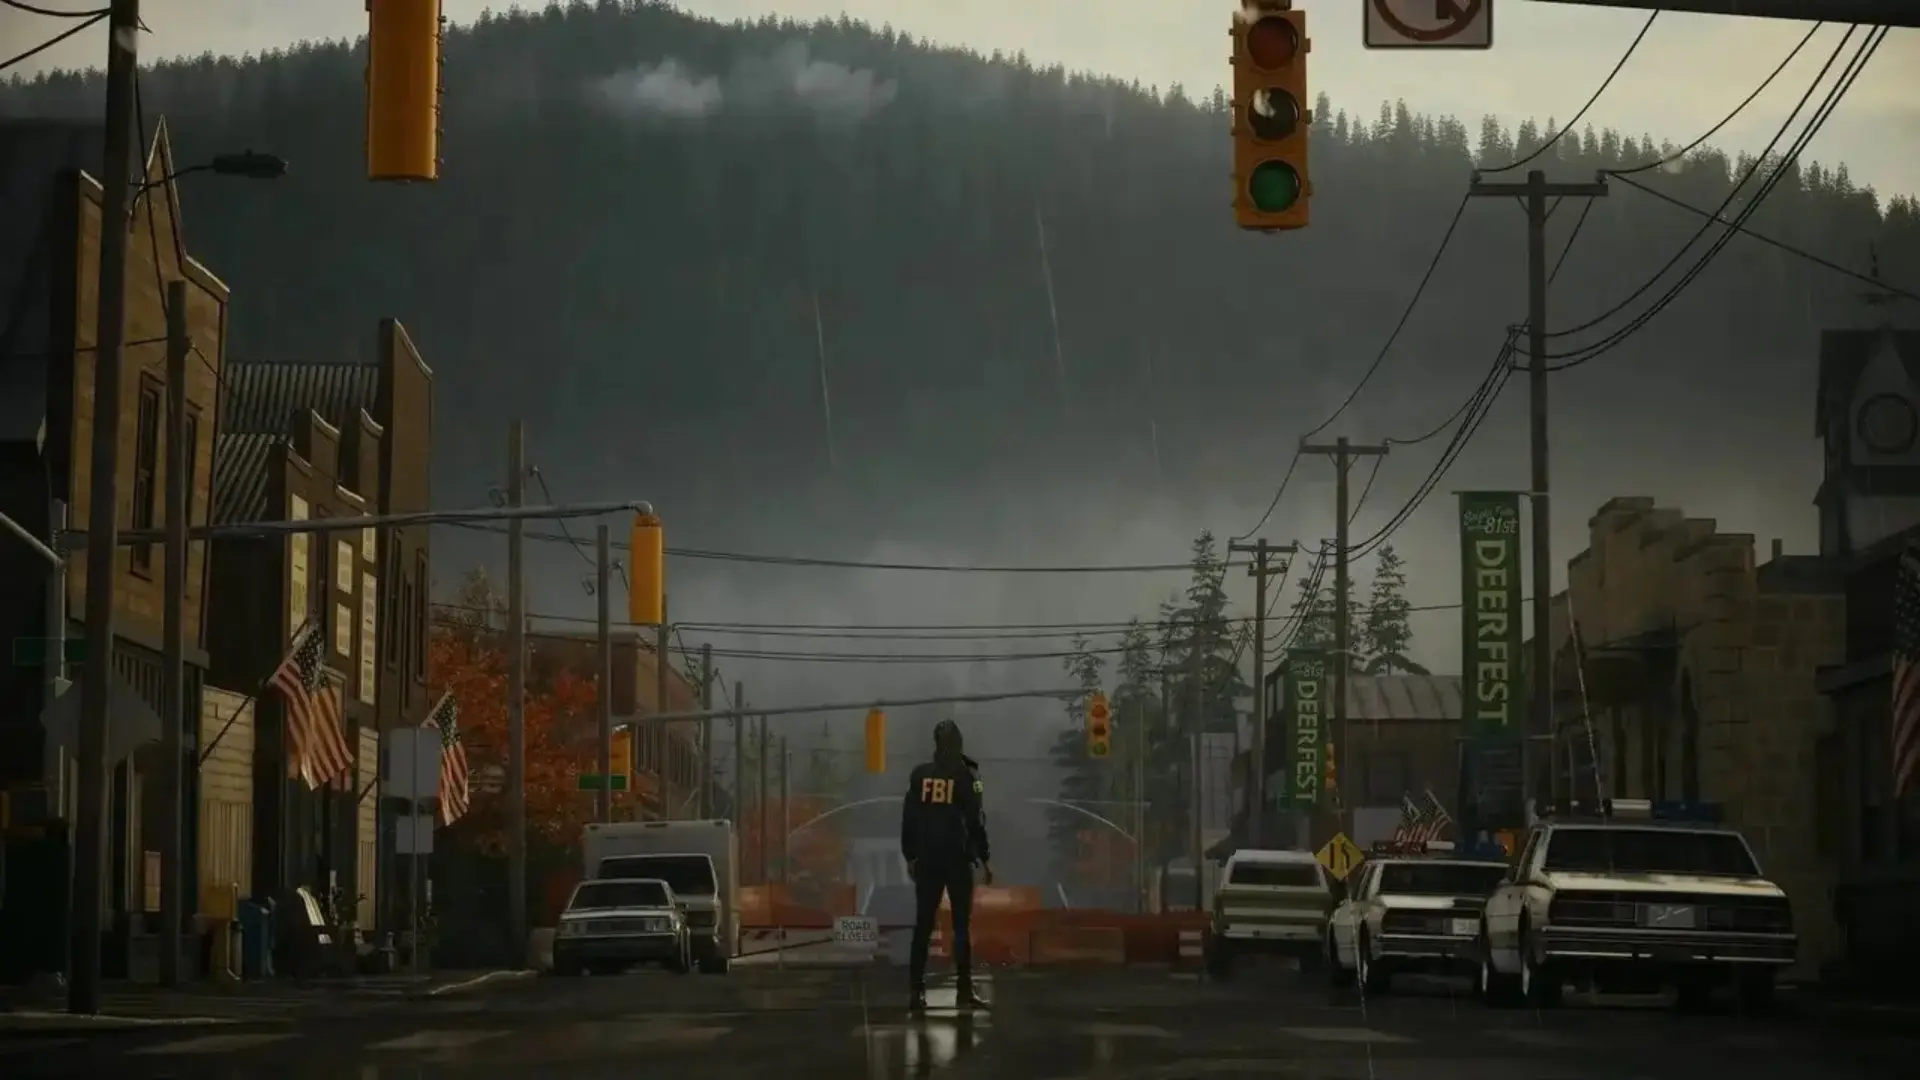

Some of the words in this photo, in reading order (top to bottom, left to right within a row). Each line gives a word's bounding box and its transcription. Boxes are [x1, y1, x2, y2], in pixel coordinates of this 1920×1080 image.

[1484, 515, 1518, 534] 81st
[1475, 540, 1508, 725] DEERFEST
[1295, 681, 1318, 804] DEERFEST
[921, 777, 954, 805] FBI
[842, 920, 871, 930] ROAD
